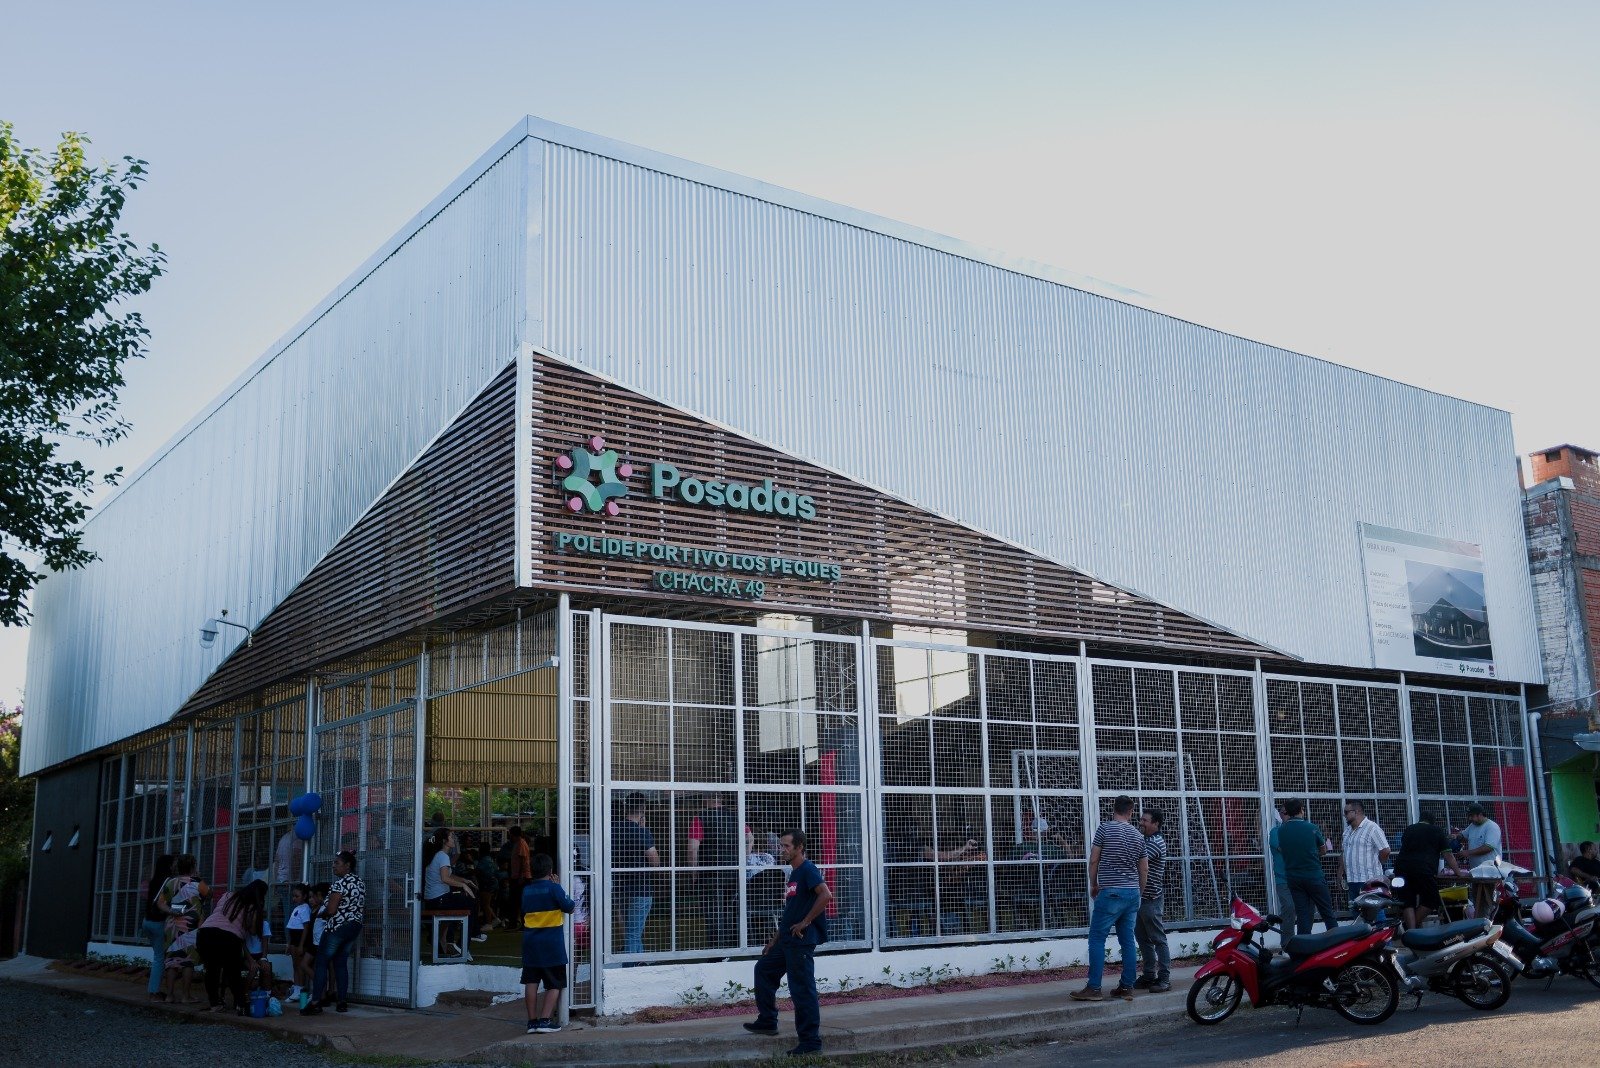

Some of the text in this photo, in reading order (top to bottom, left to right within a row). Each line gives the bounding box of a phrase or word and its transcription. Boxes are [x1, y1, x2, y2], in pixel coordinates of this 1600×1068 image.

[652, 462, 816, 520] Posadas
[559, 532, 842, 580] POLIDEPORTIVO LOS PEQUES
[659, 570, 766, 600] CHACRA 49
